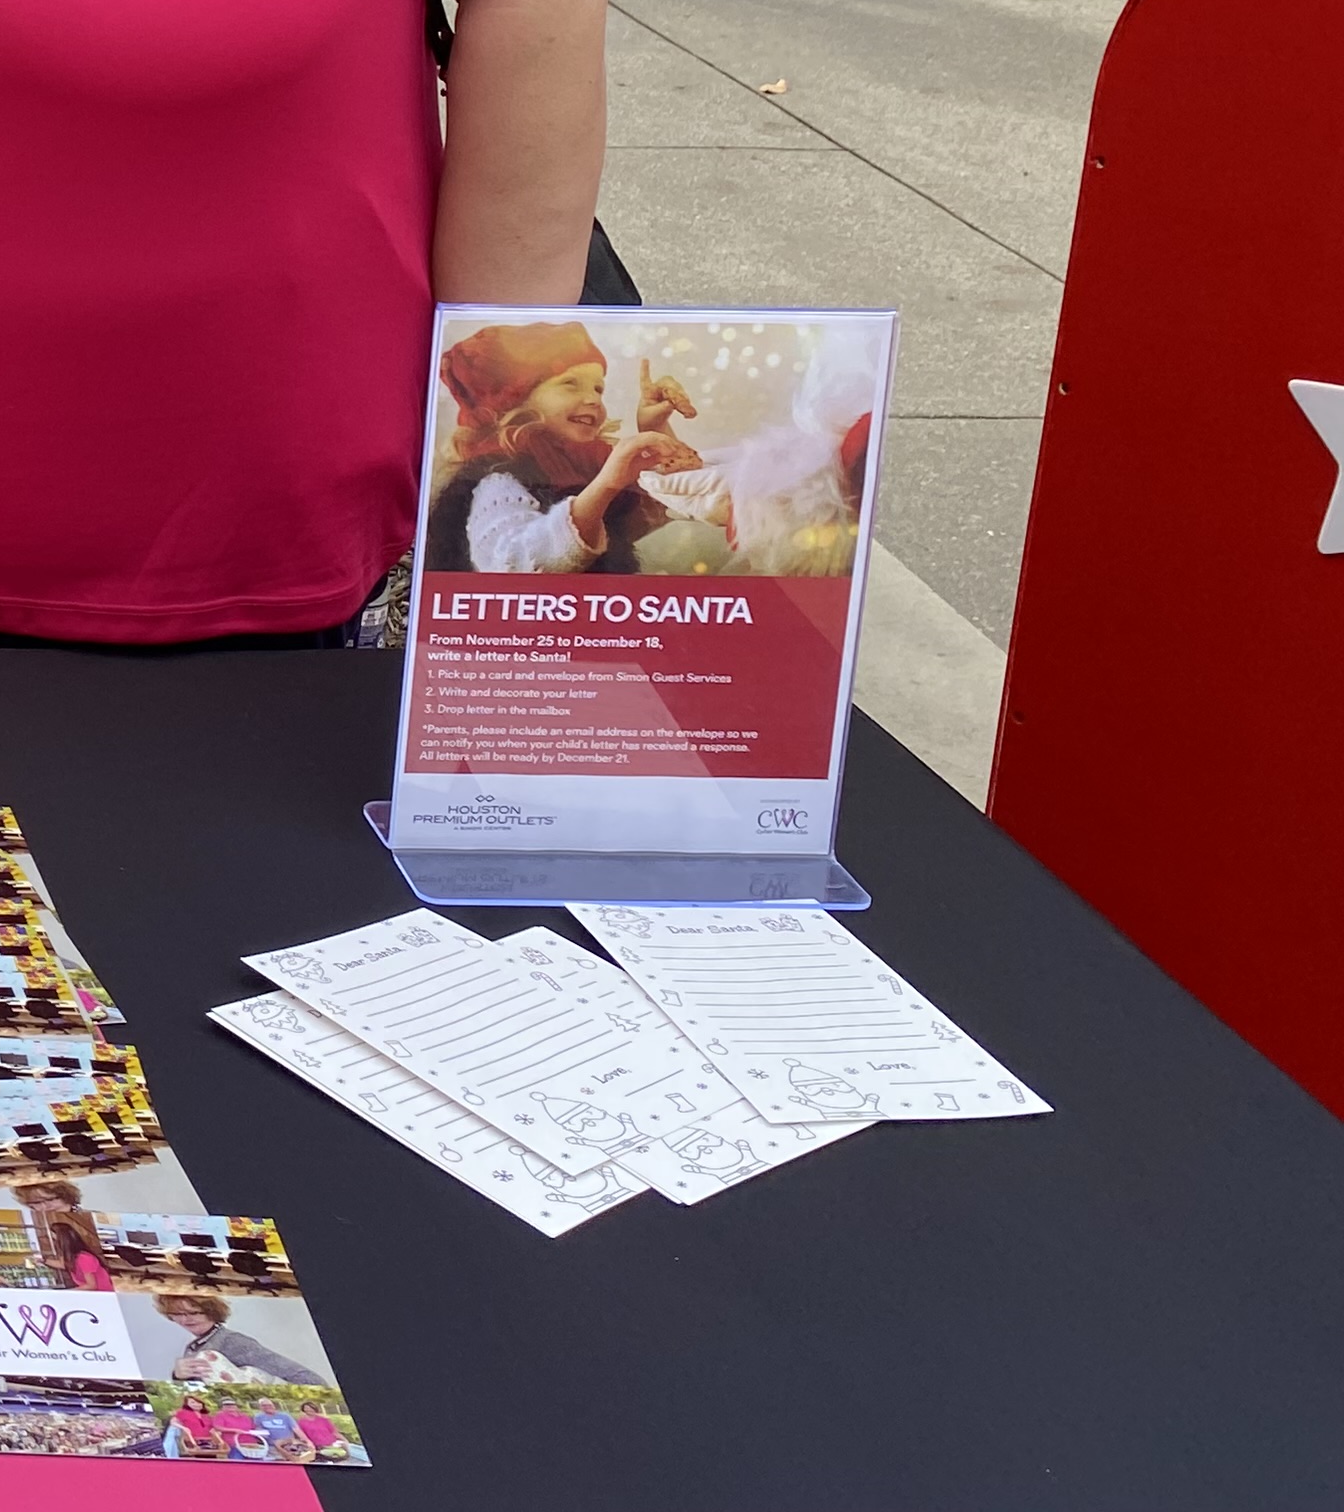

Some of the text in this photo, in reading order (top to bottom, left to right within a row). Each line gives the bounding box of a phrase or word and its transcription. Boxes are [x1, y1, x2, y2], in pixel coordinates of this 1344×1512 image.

[431, 593, 753, 624] LETTERS TO SANTA
[429, 634, 664, 650] From November 25 to December 18,
[427, 651, 571, 663] write a letter to Santa!
[438, 670, 460, 679] Pick
[463, 672, 476, 682] up
[479, 672, 486, 680] a
[488, 670, 512, 680] card
[515, 671, 534, 680] and
[537, 671, 585, 682] envelope
[588, 672, 613, 681] from
[616, 672, 650, 682] Simon
[652, 672, 684, 683] Guest
[687, 673, 732, 684] Services
[438, 687, 468, 697] Write
[470, 688, 490, 697] and
[492, 688, 540, 698] decorate
[542, 690, 567, 700] your
[569, 689, 598, 698] letter
[437, 704, 464, 715] Drop
[466, 705, 495, 714] letter
[498, 705, 507, 714] in
[509, 706, 527, 715] the
[529, 706, 571, 716] mailbox
[472, 725, 507, 736] please
[509, 725, 548, 736] include
[550, 727, 563, 736] an
[565, 727, 594, 736] email
[596, 727, 638, 737] address
[640, 729, 654, 737] on
[656, 728, 674, 737] the
[676, 729, 725, 739] envelope
[726, 730, 739, 738] so
[741, 731, 758, 739] we
[448, 805, 521, 815] HOUSTON
[413, 815, 554, 825] PREMIUM OUTLETS
[757, 808, 809, 829] CWC
[665, 925, 704, 935] Dear
[333, 958, 365, 972] Dear
[12, 1347, 79, 1362] Women's
[82, 1349, 116, 1363] Club
